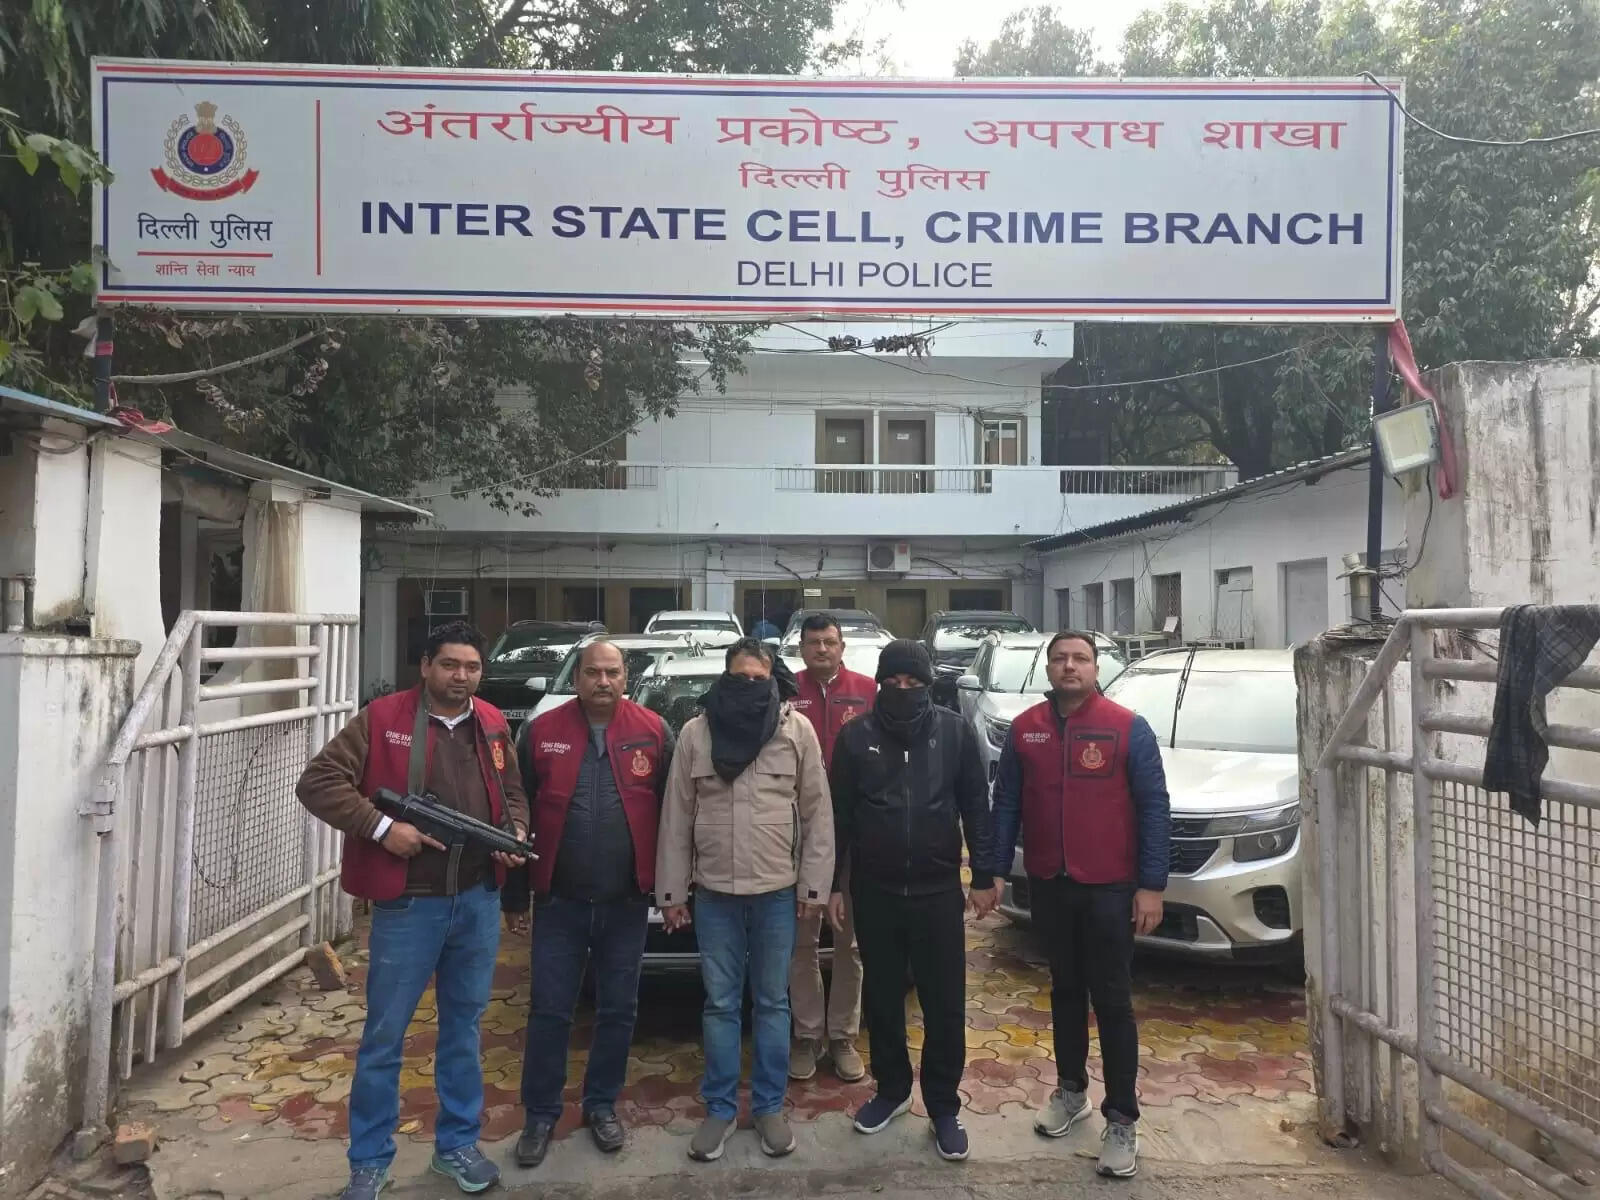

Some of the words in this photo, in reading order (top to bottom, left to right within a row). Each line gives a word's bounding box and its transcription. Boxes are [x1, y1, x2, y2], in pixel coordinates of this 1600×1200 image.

[378, 104, 681, 145] अंतर्राज्यीय
[718, 110, 920, 150] प्रकोष्ठ,
[966, 123, 1165, 150] अपराध
[1205, 124, 1348, 150] शाखा
[740, 163, 849, 190] दिल्ली
[879, 165, 990, 199] पुलिस
[137, 213, 200, 241] दिल्ली
[210, 214, 273, 249] पुलिस
[363, 203, 533, 237] INTER
[553, 206, 727, 241] STATE
[748, 211, 904, 250] CELL,
[927, 212, 1104, 244] CRIME
[1126, 214, 1363, 246] BRANCH
[196, 261, 220, 277] सेवा
[227, 265, 256, 277] न्याय
[739, 262, 844, 287] DELHI
[860, 263, 993, 288] POLICE
